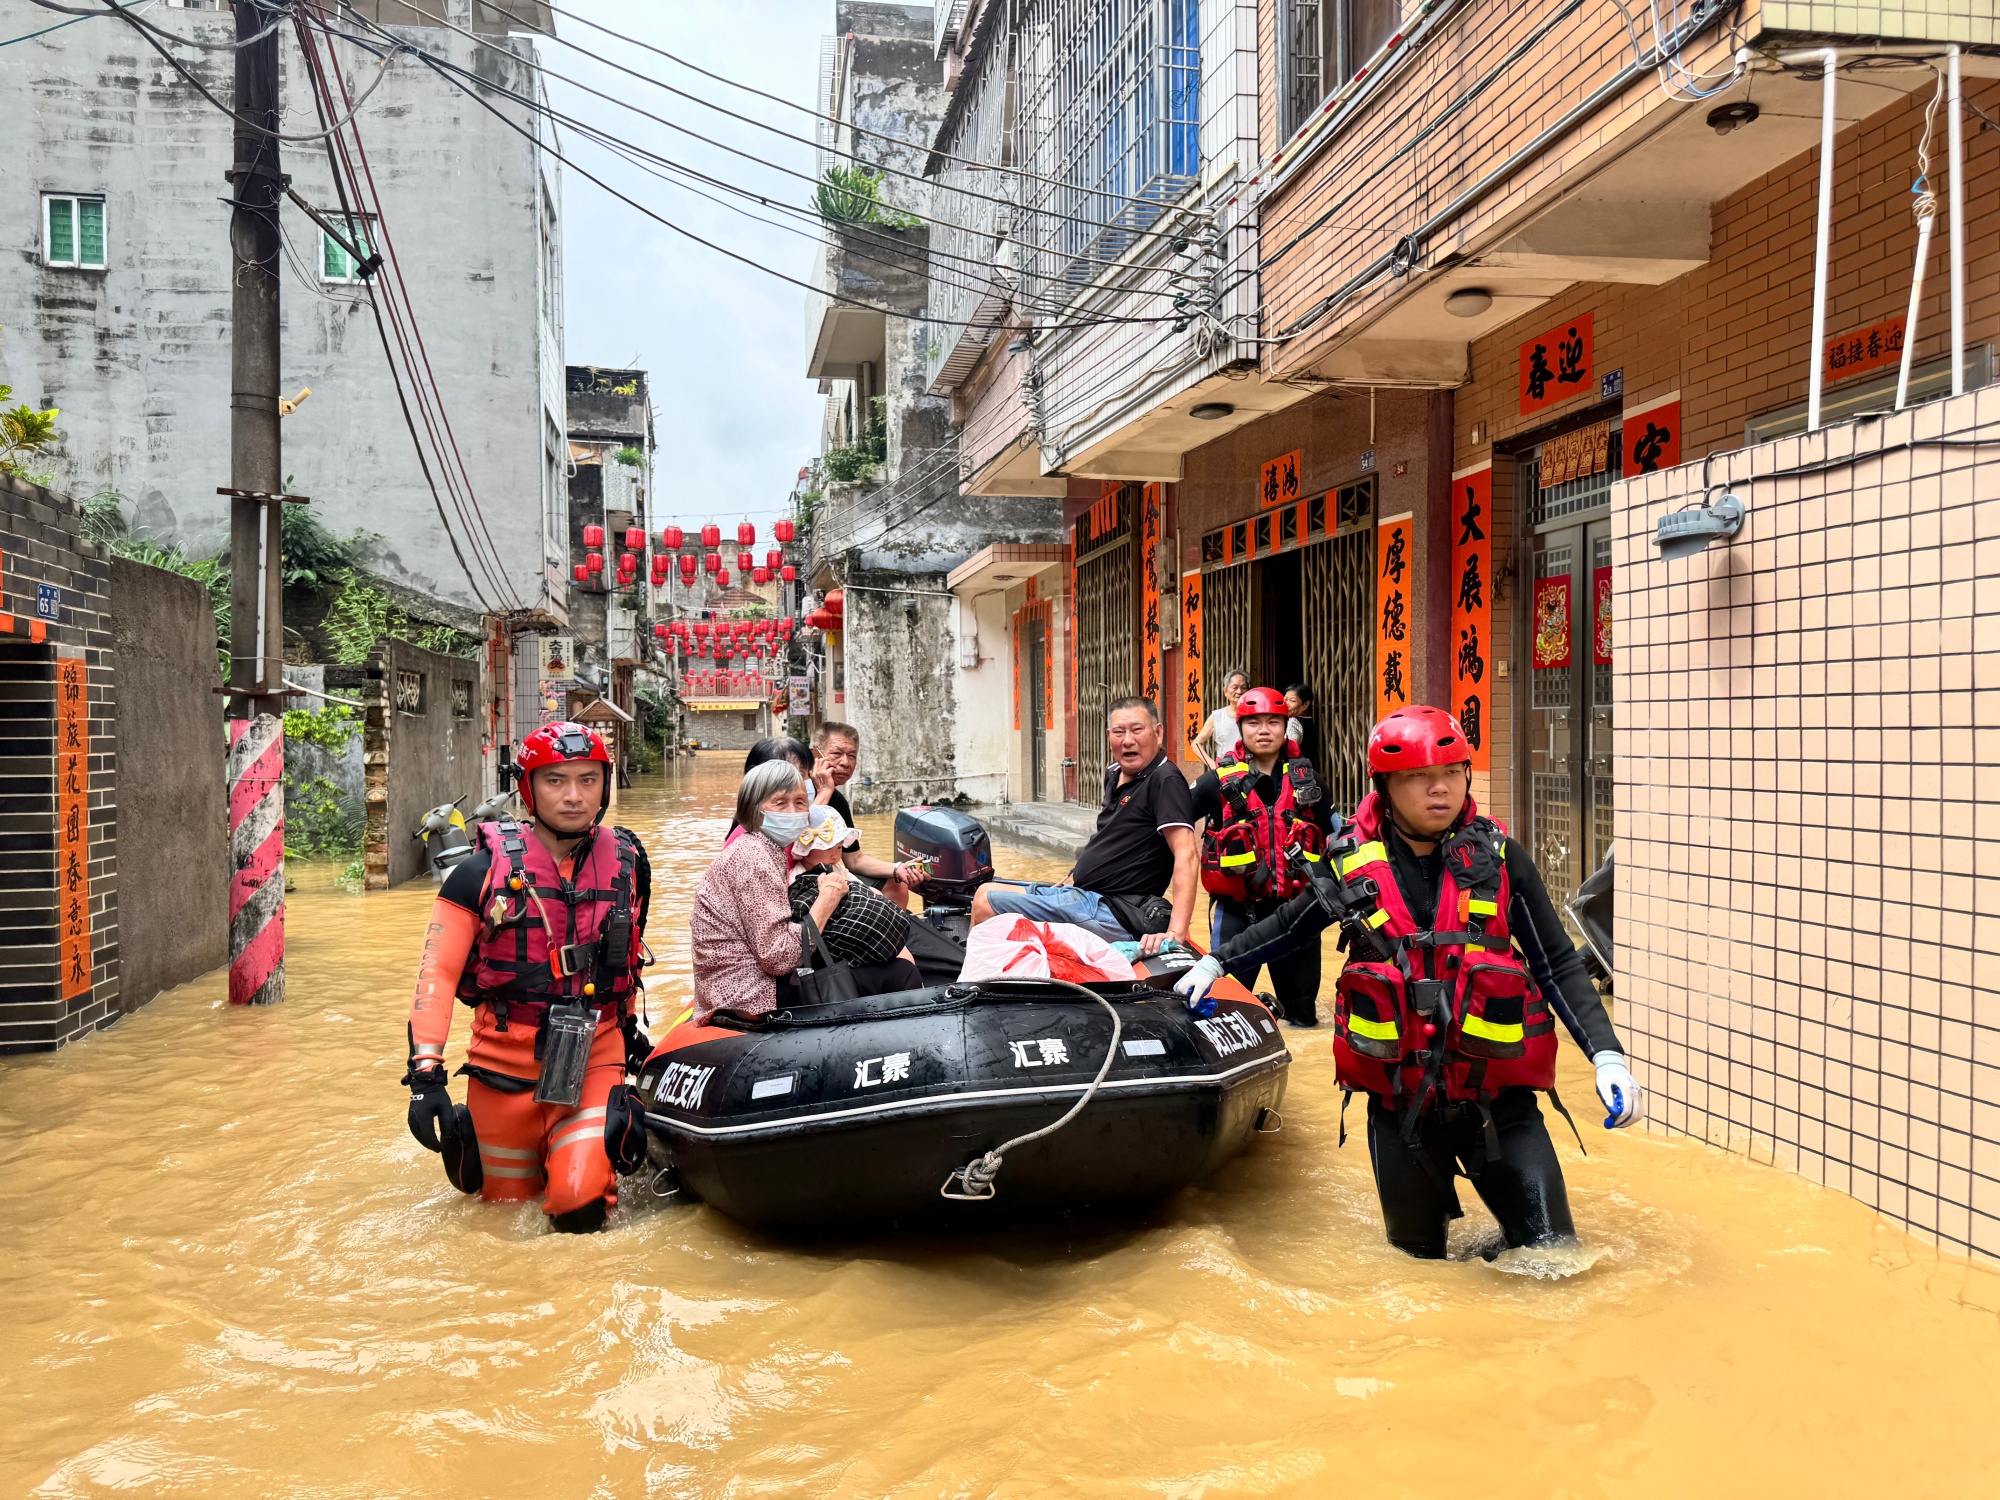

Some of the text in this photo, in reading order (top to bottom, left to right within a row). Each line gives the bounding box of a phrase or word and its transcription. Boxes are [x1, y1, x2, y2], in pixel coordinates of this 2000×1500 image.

[39, 597, 49, 614] 65
[414, 922, 445, 1011] RESCUE
[853, 1051, 911, 1090] 汇豪
[1009, 1038, 1070, 1068] 汇豪
[653, 1061, 716, 1111] 阳江支队
